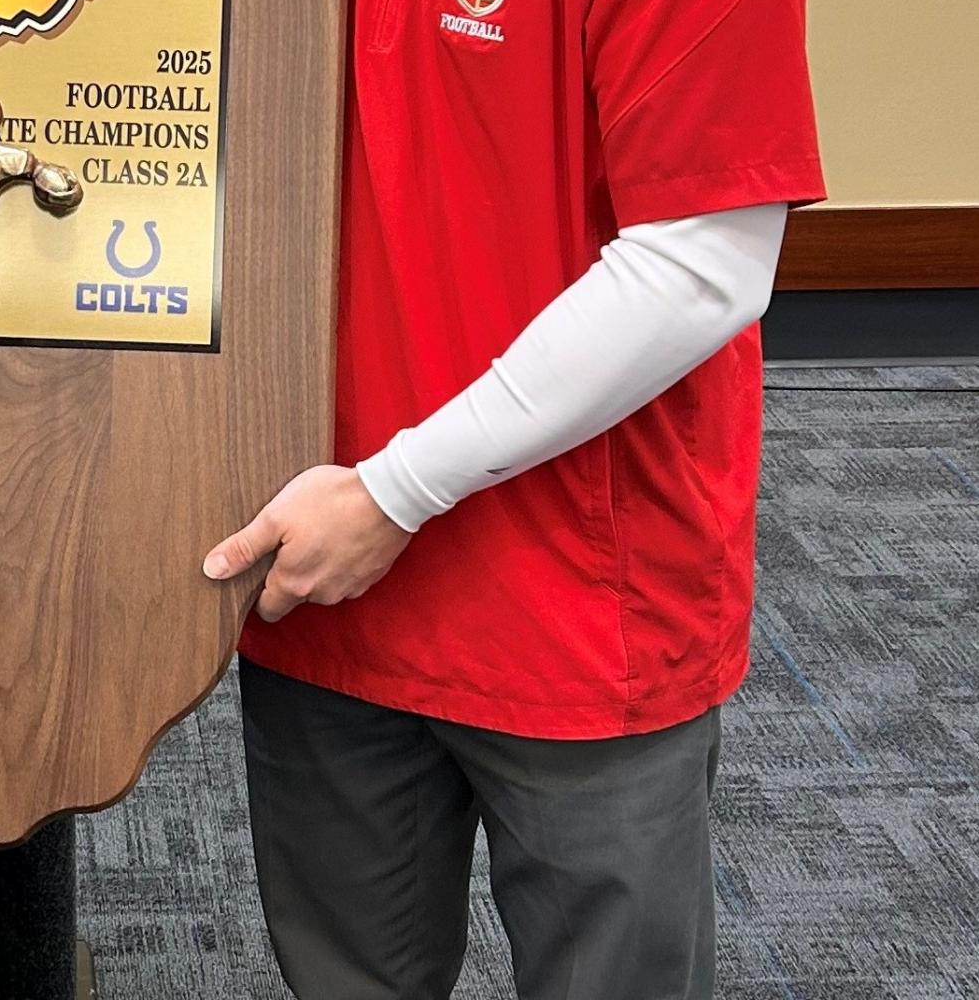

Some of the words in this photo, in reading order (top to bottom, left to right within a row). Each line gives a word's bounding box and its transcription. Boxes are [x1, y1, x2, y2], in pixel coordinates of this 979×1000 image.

[439, 12, 504, 42] FOOTBALL
[156, 49, 212, 75] 2025
[65, 82, 211, 112] FOOTBALL
[44, 118, 210, 150] CHAMPIONS
[82, 158, 169, 186] CLASS
[176, 162, 209, 187] 2A
[75, 282, 189, 315] COLTS
